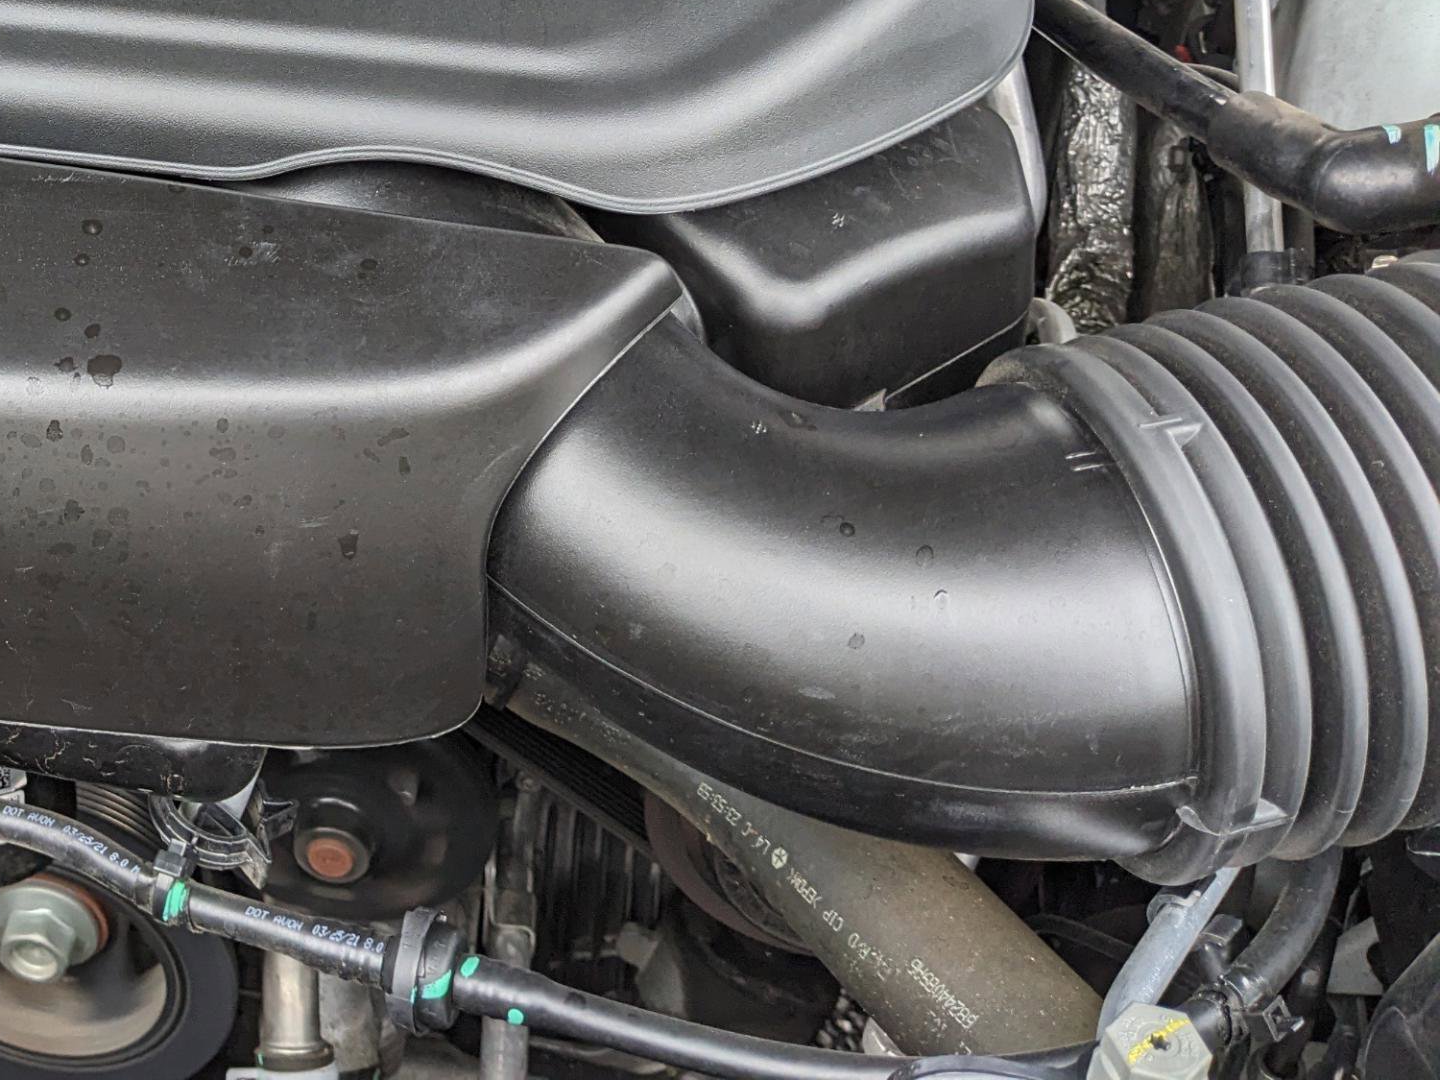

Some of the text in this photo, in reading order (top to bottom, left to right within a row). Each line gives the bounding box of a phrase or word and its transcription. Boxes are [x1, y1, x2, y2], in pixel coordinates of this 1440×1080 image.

[3, 805, 25, 818] DOT
[245, 906, 270, 920] DOT
[363, 937, 385, 953] 8.0
